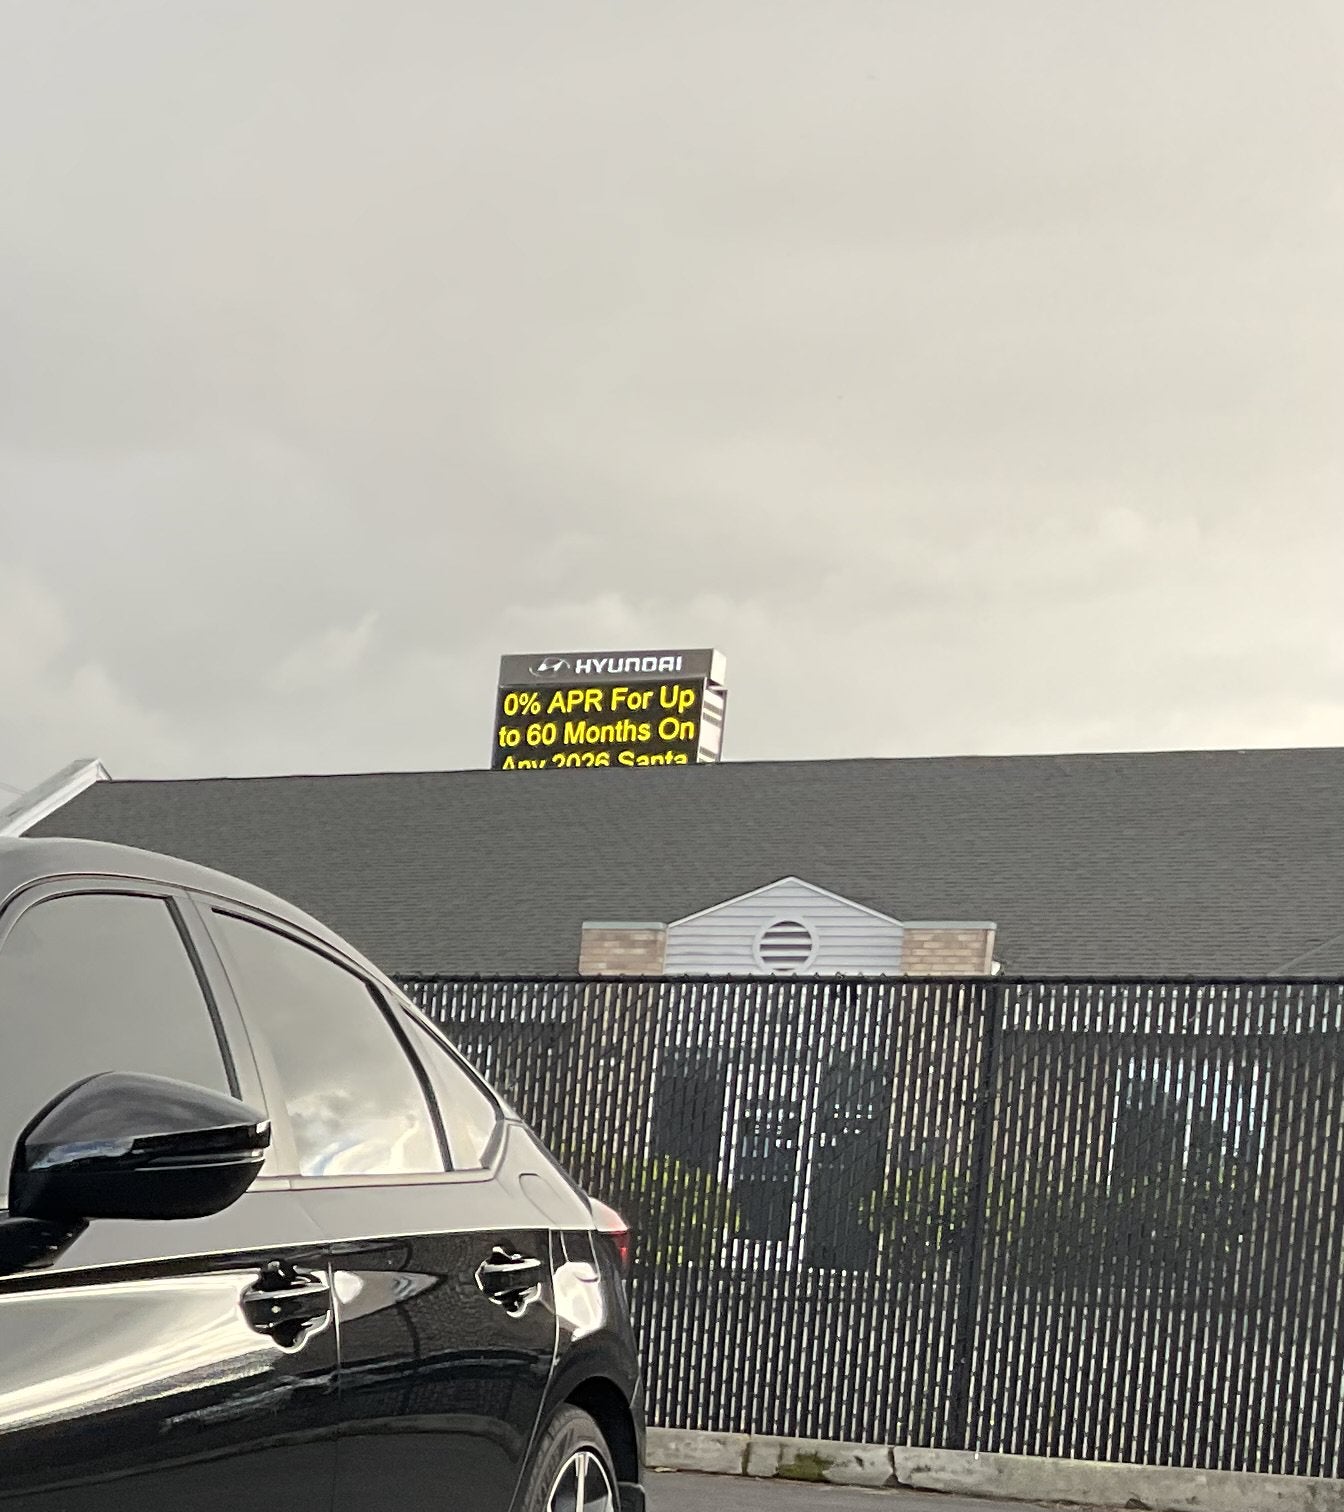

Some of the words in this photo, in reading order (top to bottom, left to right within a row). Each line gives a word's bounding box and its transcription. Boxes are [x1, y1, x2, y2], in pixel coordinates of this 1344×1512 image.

[575, 656, 683, 674] HYUNDAI
[503, 692, 541, 716] 0%
[547, 689, 603, 714] APR
[611, 687, 654, 711] For
[660, 685, 696, 714] Up
[498, 725, 521, 747] to
[526, 723, 557, 746] 60
[563, 718, 651, 745] Months
[658, 717, 696, 740] On
[617, 750, 688, 767] Santa
